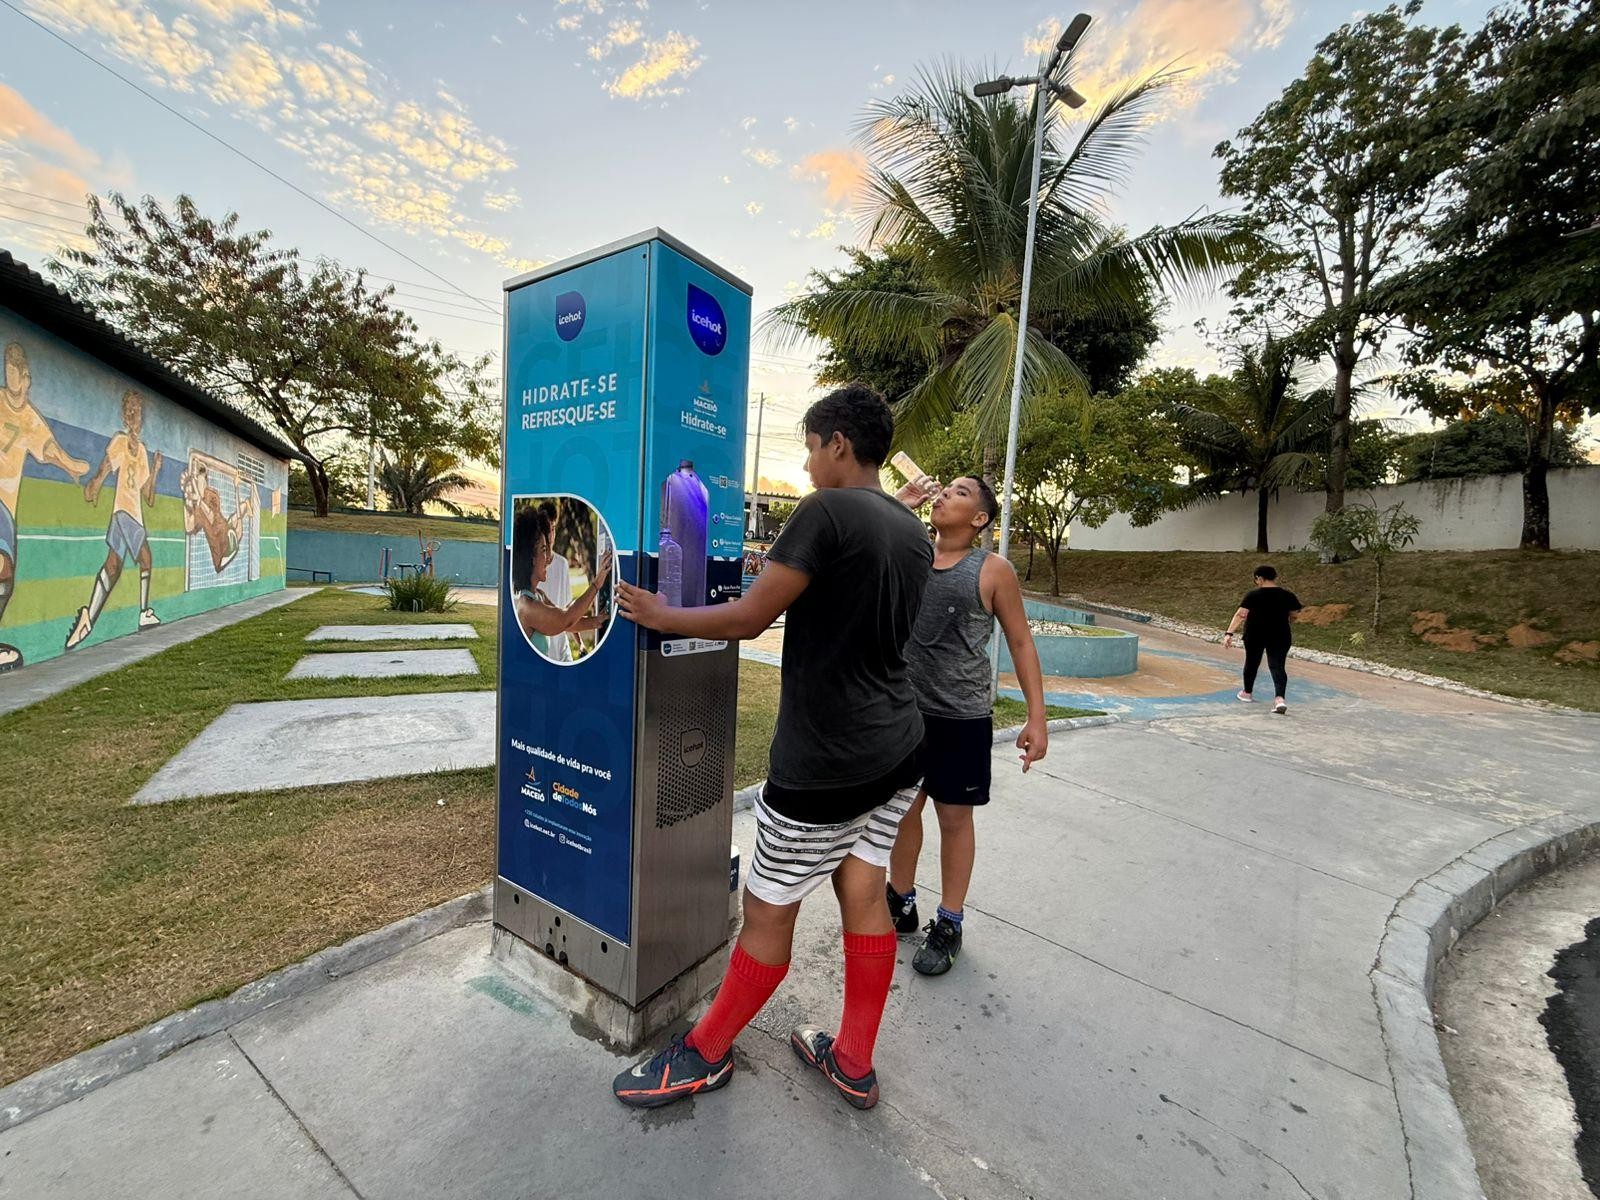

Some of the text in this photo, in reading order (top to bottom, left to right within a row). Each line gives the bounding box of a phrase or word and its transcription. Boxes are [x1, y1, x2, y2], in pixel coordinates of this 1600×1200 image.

[558, 310, 582, 325] icehot
[691, 309, 723, 335] icehot
[522, 373, 618, 406] HIDRATE-SE
[521, 400, 616, 430] REFRESQUE-SE
[681, 410, 727, 436] Hidrate-se
[511, 738, 612, 781] Mais qualidade de vida pra você
[520, 786, 545, 802] MACEIÓ
